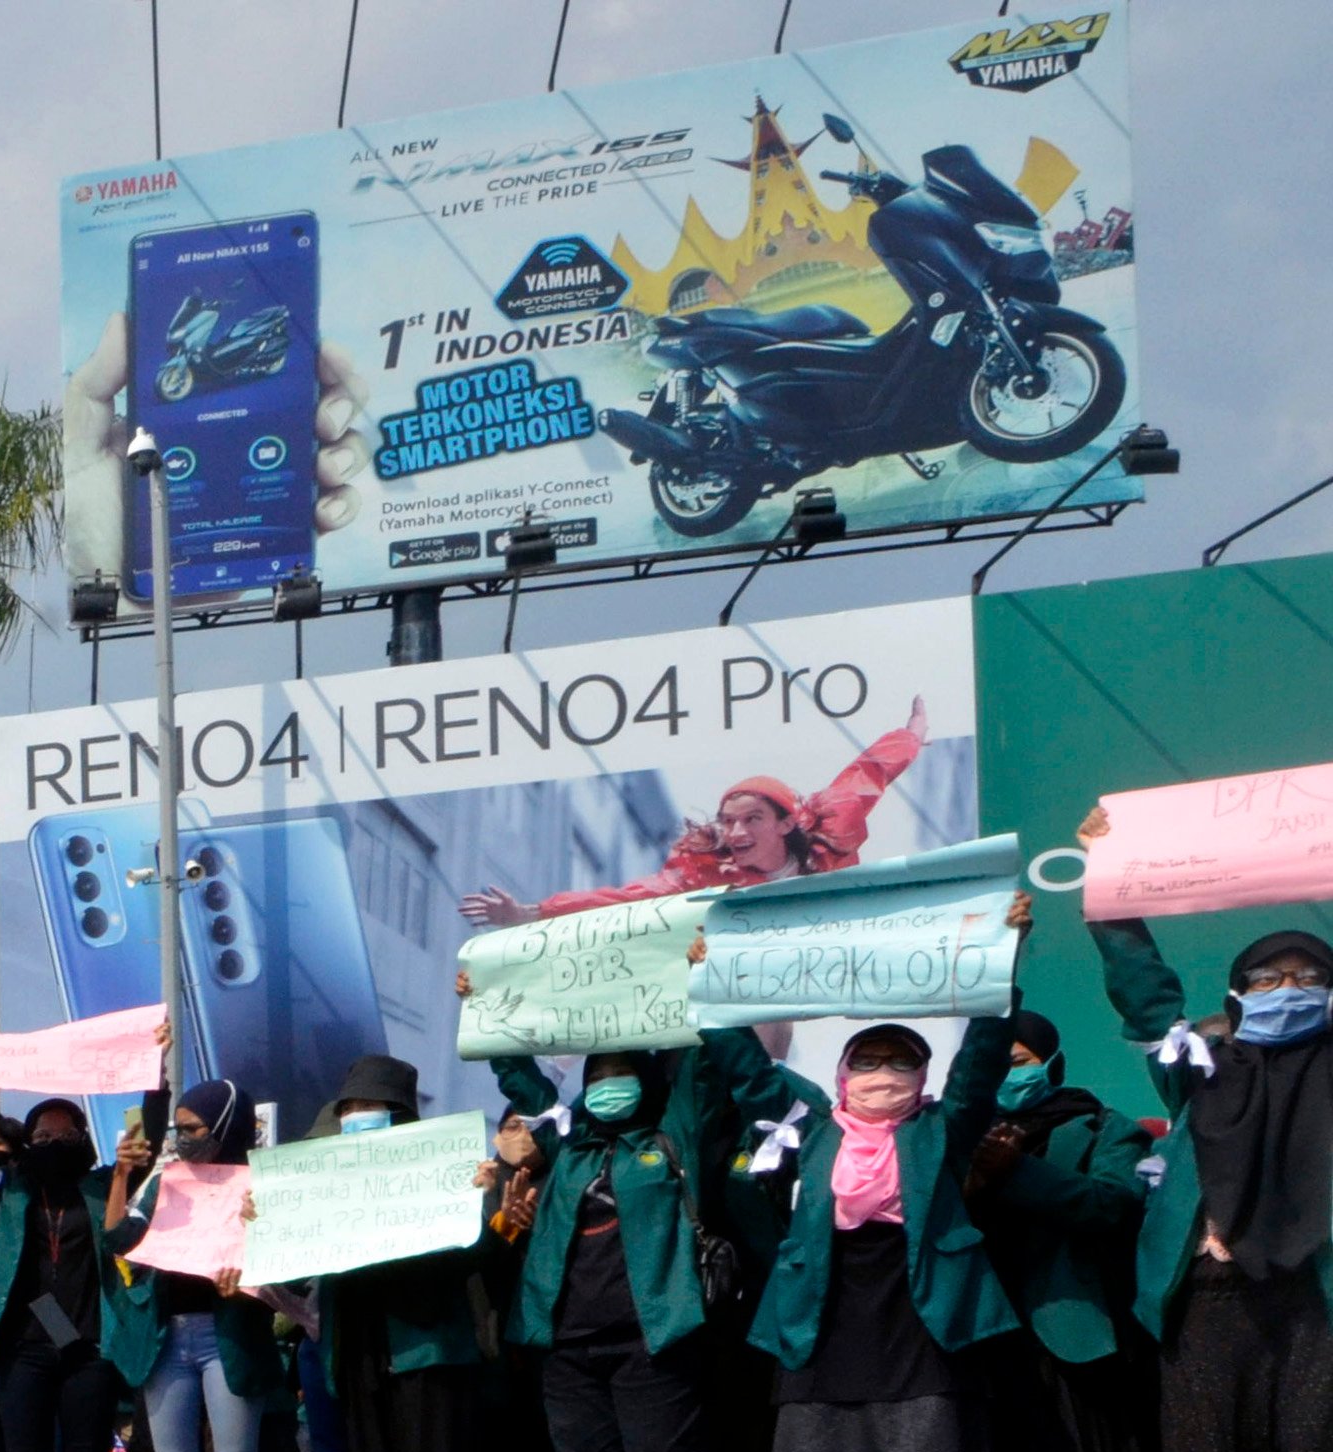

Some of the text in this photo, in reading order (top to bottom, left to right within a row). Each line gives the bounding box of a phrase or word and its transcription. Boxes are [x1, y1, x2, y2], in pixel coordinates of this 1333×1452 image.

[979, 54, 1067, 85] YAMAHA
[351, 138, 439, 164] ALL NEW
[591, 128, 693, 156] 155
[97, 171, 177, 201] YAMAHA
[487, 162, 606, 192] CONNECTED
[441, 181, 598, 218] LIVE THE PRIDE
[193, 249, 215, 262] New
[524, 264, 602, 293] YAMAHA
[507, 285, 616, 309] MOTORCYCLE
[524, 296, 599, 315] CONNECT
[380, 307, 471, 370] 1st IN
[435, 313, 629, 365] INDONESIA
[421, 363, 531, 410] MOTOR
[383, 381, 576, 446] TERKONEKSI
[379, 406, 593, 477] SMARTPHONE
[379, 491, 613, 533] (Yamaha Motorcycle Connect)
[382, 476, 610, 514] Download aplikasi Y-Connect
[408, 544, 478, 563] Google play
[374, 667, 690, 769] RENO4
[720, 655, 869, 731] Pro
[502, 897, 673, 966] BAPAK
[548, 948, 634, 993] DPR
[309, 1178, 351, 1202] suka
